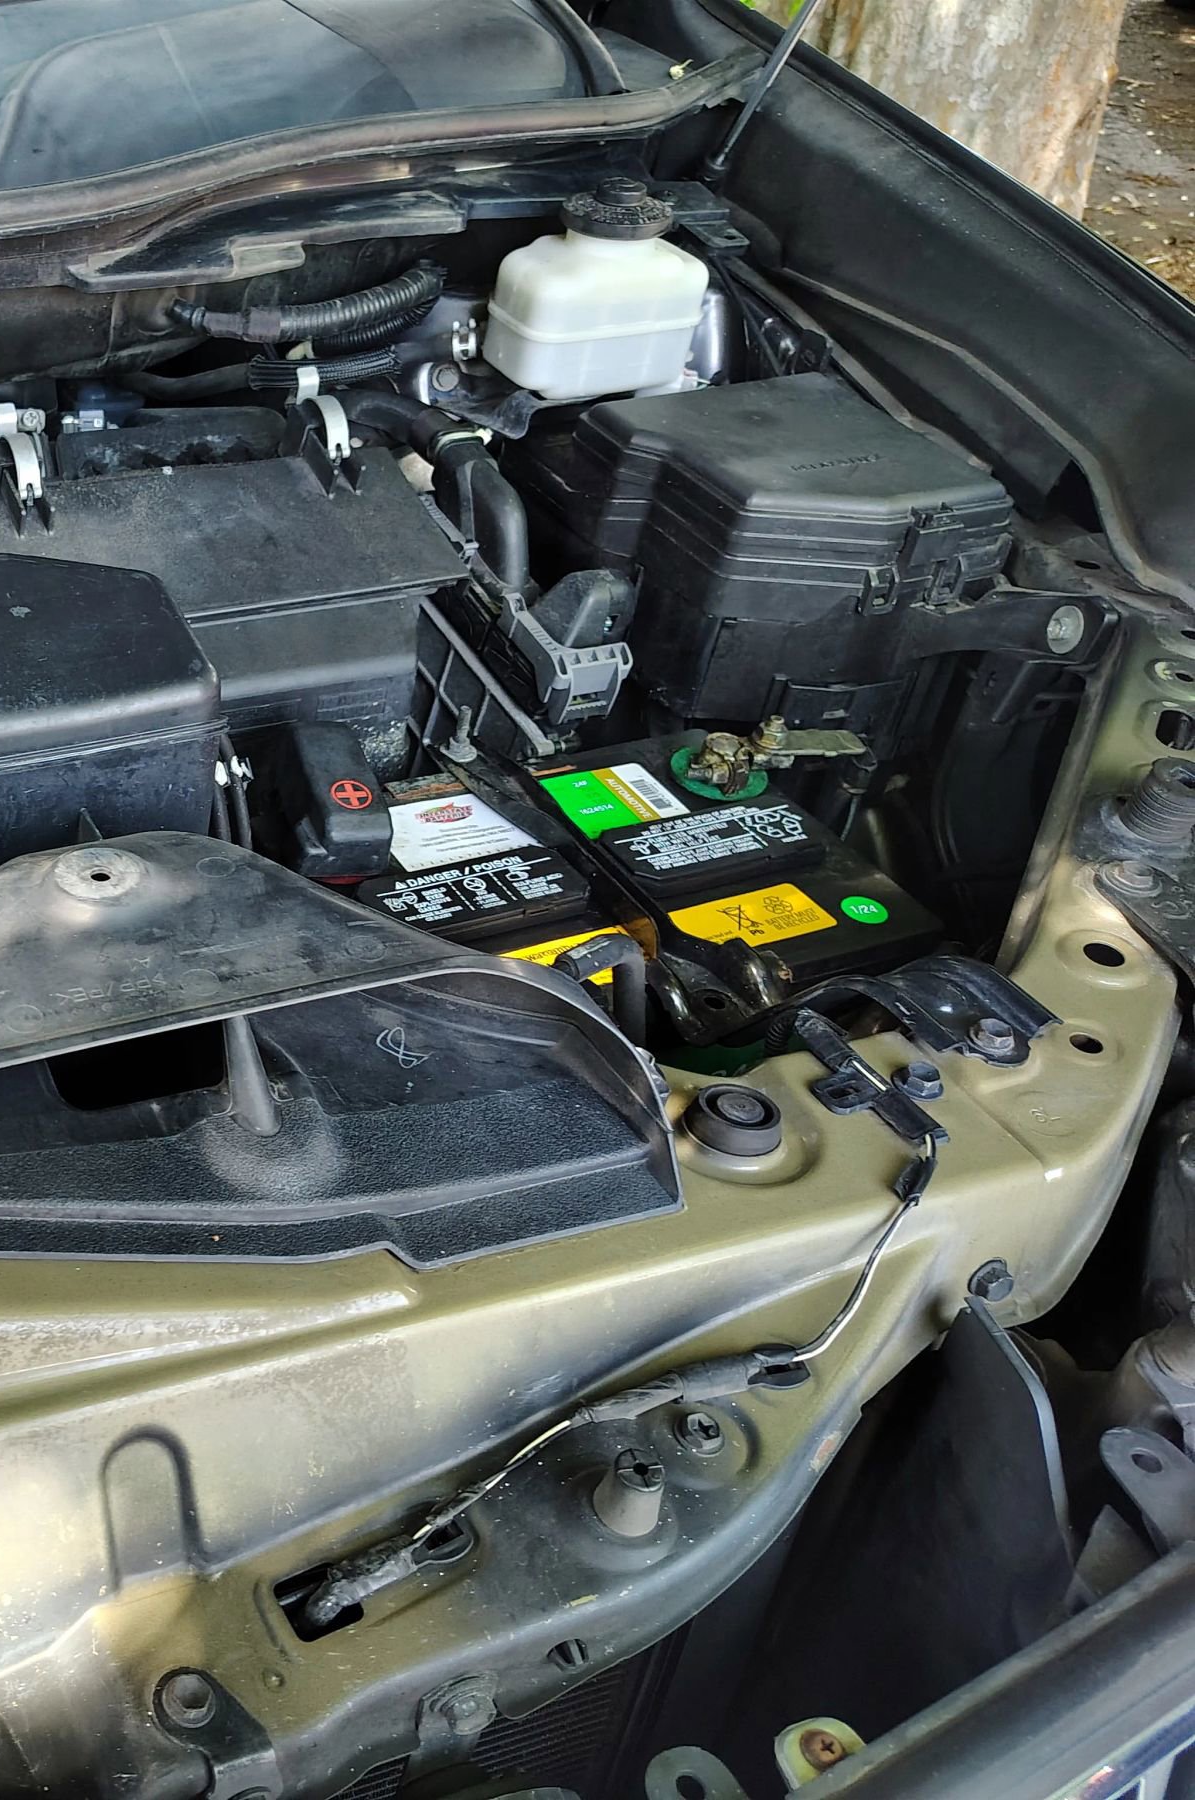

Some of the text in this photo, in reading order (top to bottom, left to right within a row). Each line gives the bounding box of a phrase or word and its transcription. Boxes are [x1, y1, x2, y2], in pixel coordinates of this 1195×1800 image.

[605, 778, 653, 818] AUTOMOTIVE
[406, 869, 463, 887] DANGER
[472, 855, 524, 872] POISON
[849, 904, 878, 915] 1/24
